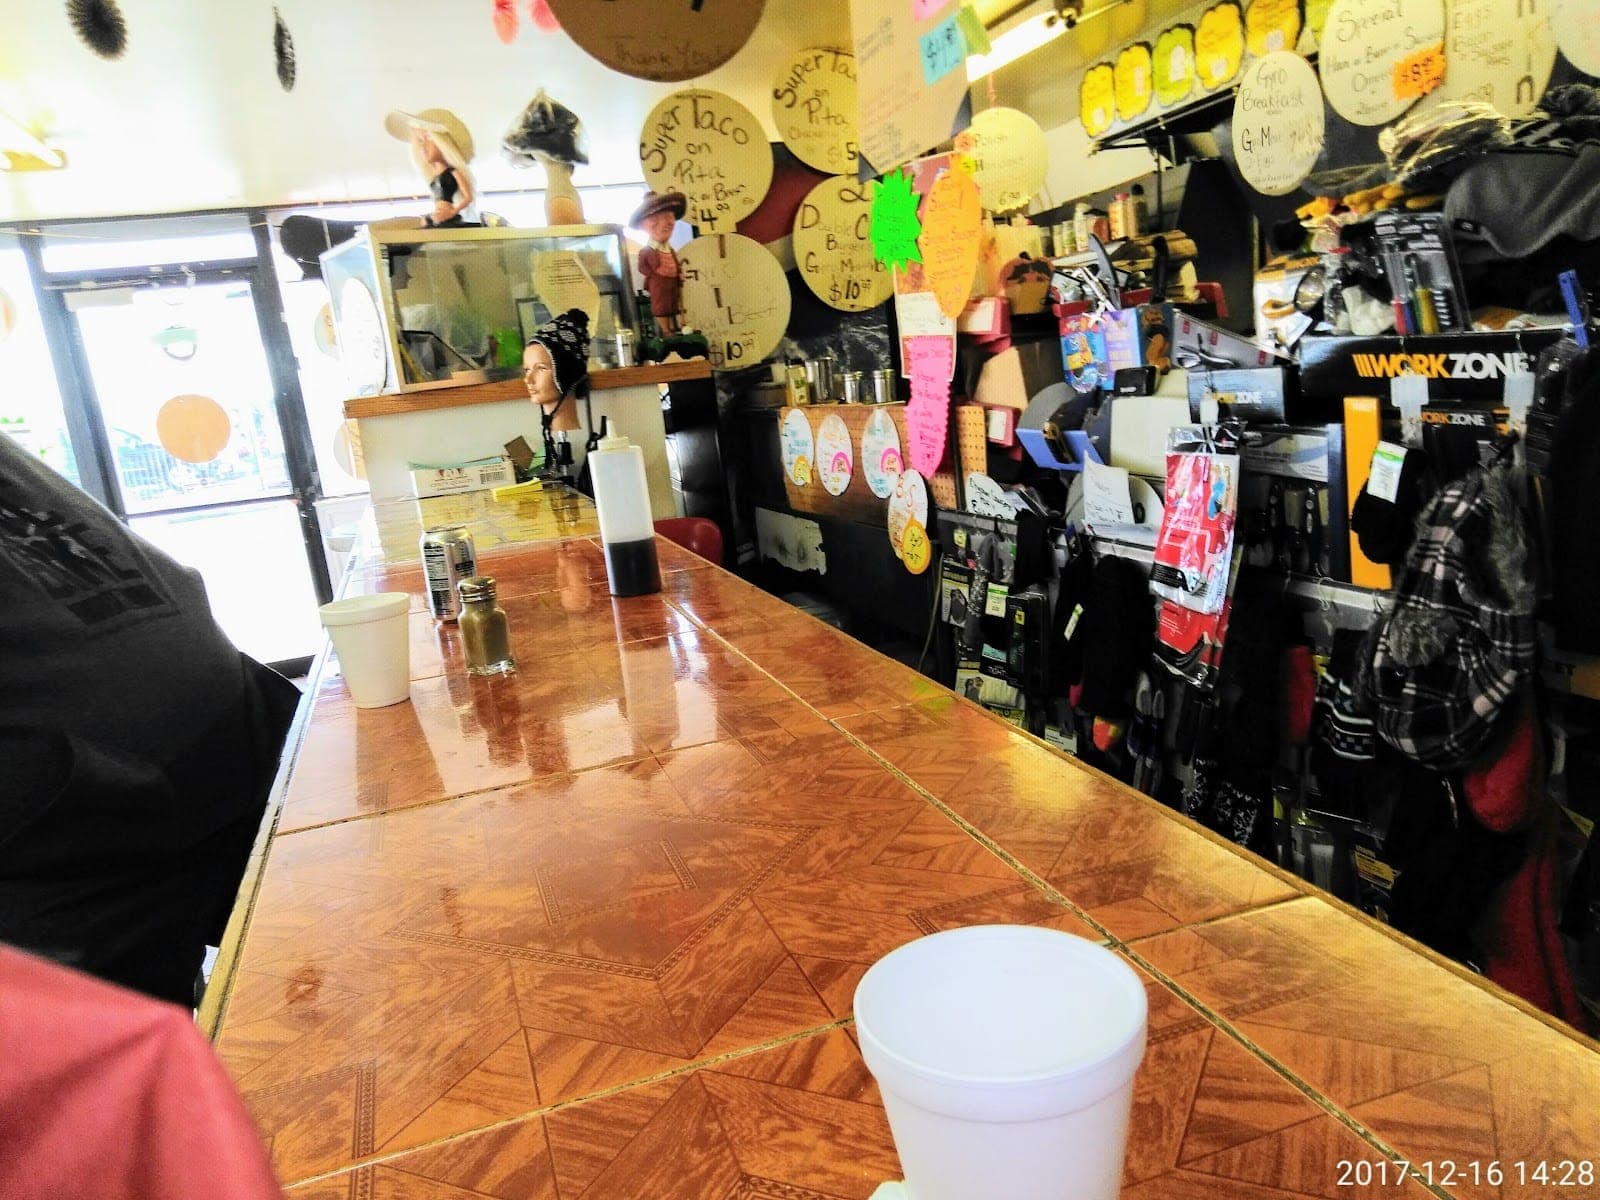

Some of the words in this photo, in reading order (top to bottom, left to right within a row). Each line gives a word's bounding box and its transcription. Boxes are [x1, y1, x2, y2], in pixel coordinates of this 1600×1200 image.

[773, 54, 824, 109] Super
[801, 97, 849, 125] Pita
[640, 106, 681, 173] Super
[675, 94, 750, 145] Taco
[686, 142, 713, 155] on
[673, 158, 726, 184] Pita
